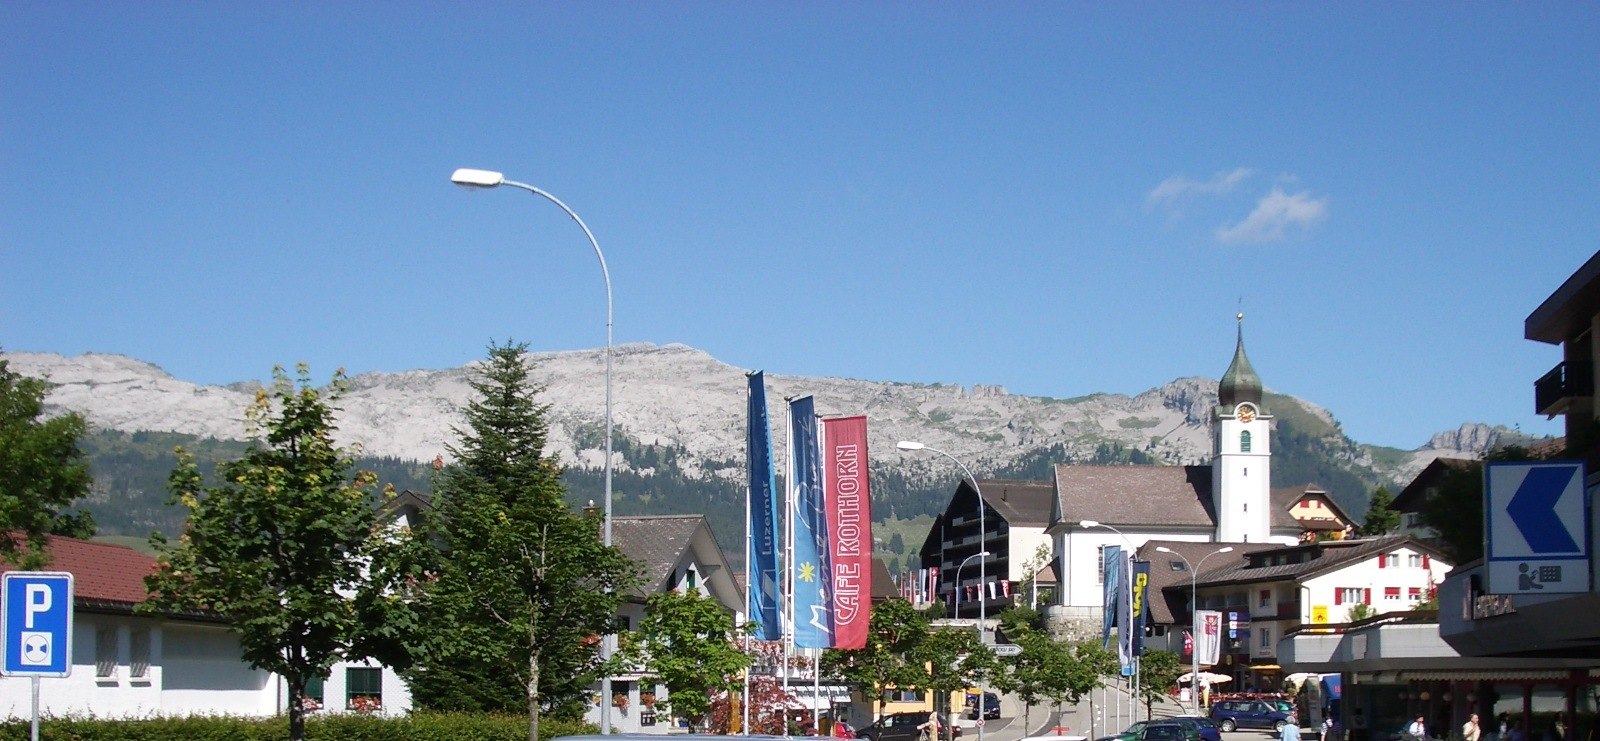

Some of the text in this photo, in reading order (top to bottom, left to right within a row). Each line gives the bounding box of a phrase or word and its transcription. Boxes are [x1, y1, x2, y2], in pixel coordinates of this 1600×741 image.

[762, 481, 772, 555] Luzerner
[834, 444, 861, 625] CAFE ROTHORN
[25, 583, 52, 628] P
